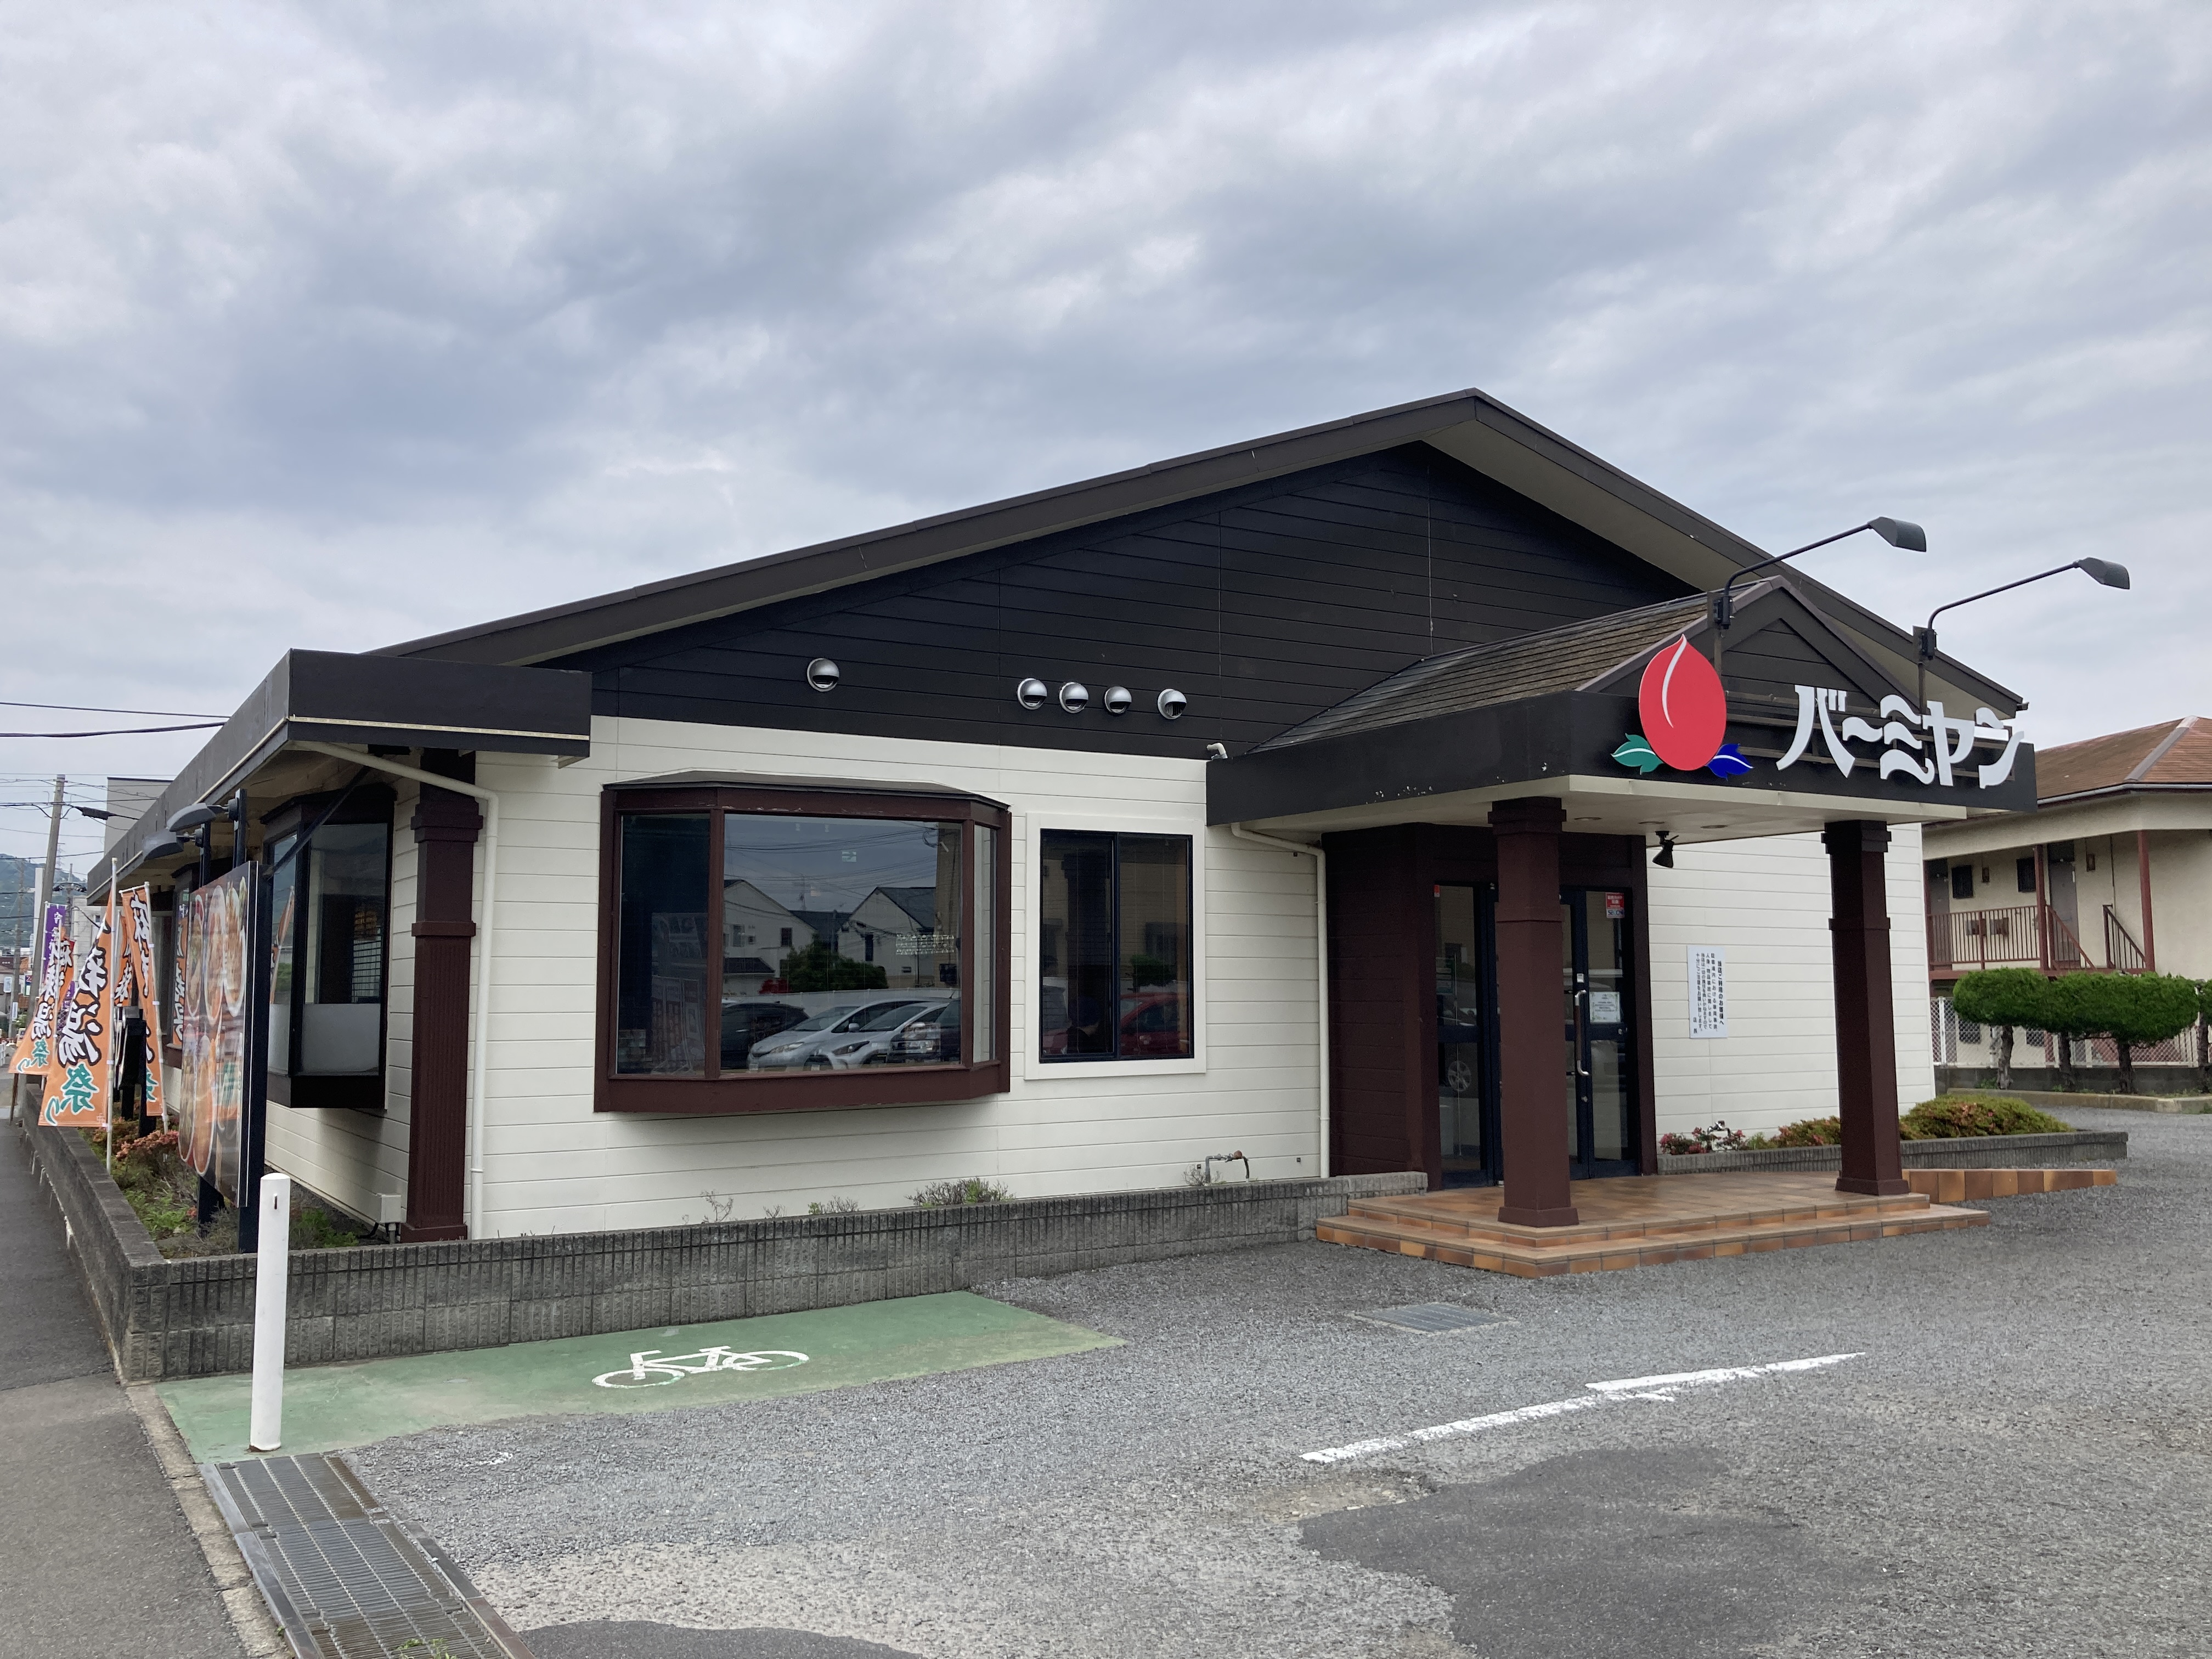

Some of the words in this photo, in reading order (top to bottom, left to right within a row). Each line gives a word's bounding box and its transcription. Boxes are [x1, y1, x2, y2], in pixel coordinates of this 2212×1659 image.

[1776, 685, 2025, 789] バーミヤン
